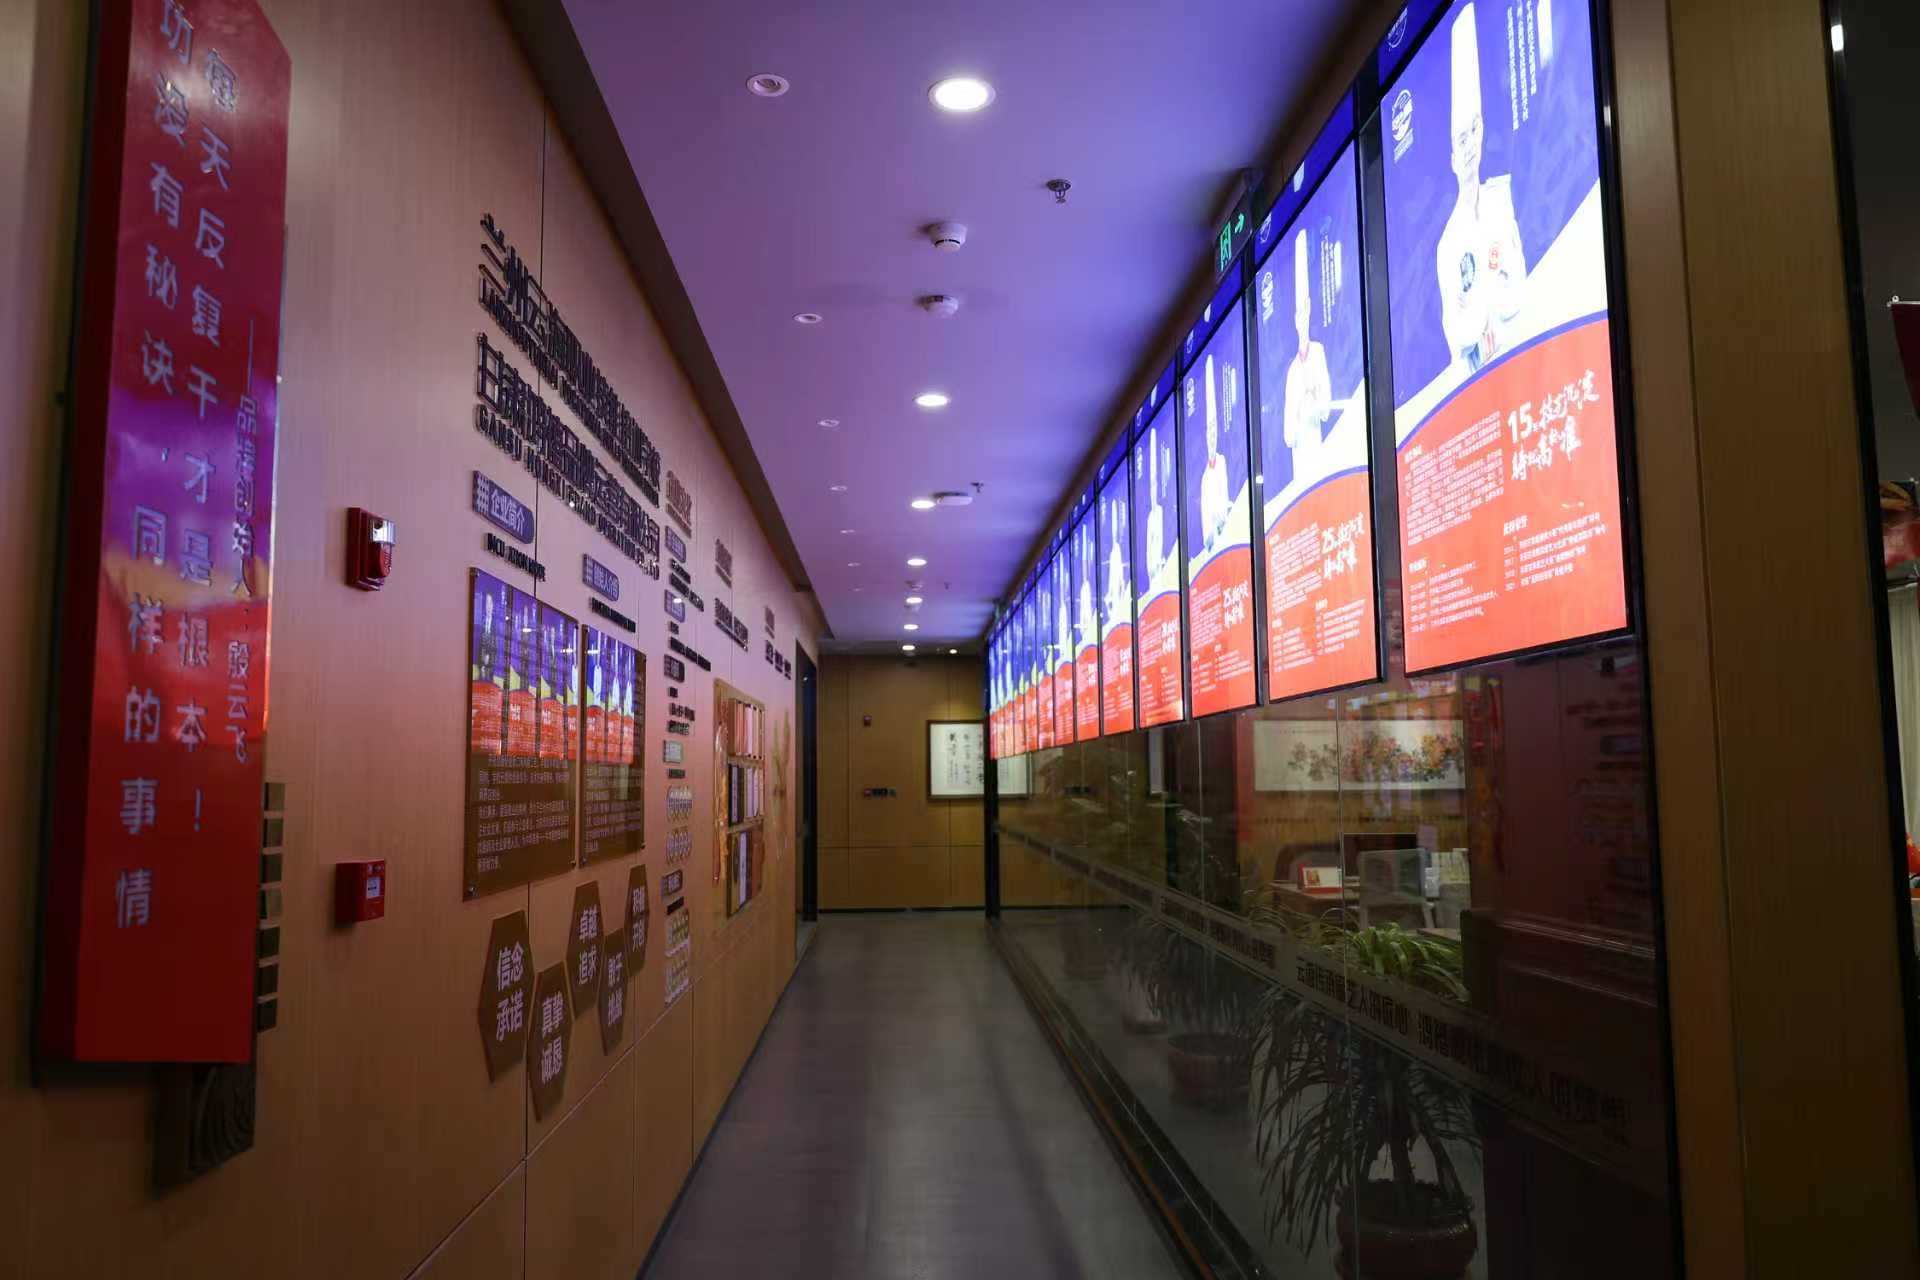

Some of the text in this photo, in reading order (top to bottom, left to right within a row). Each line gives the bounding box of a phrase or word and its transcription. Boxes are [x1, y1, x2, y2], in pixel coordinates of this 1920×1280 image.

[497, 942, 524, 991] 信念
[578, 947, 598, 985] 追求
[496, 989, 524, 1041] 承诺
